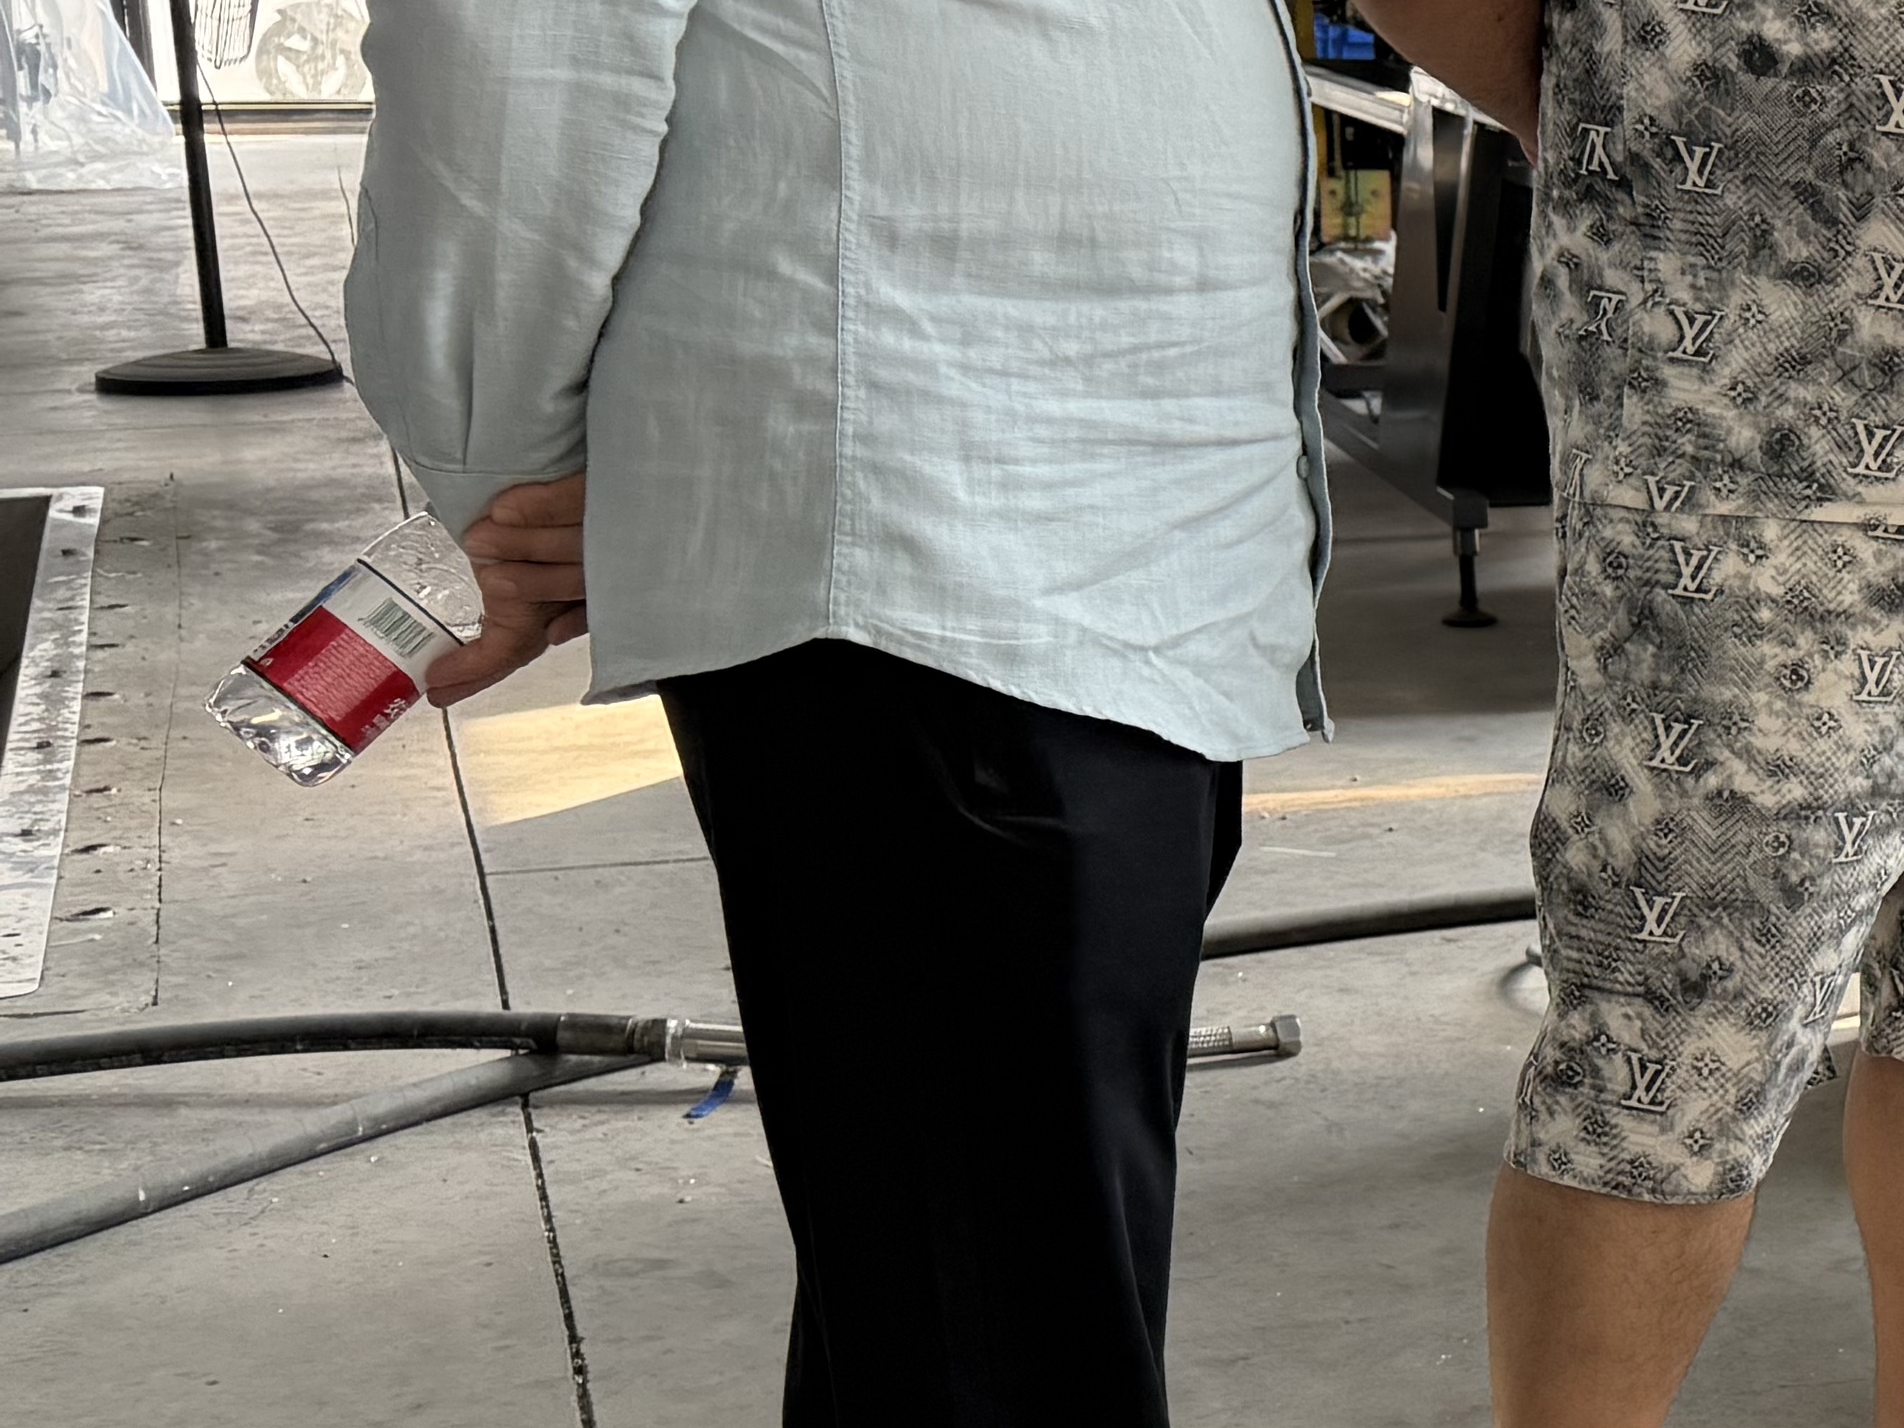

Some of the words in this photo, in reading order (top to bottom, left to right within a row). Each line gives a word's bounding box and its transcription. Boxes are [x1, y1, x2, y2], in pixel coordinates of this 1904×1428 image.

[1671, 136, 1724, 194] LV
[1669, 306, 1724, 362] LV
[1668, 542, 1723, 599] LV
[1854, 650, 1899, 702] LV
[1648, 713, 1702, 771] LV
[1630, 887, 1687, 943] LV
[1621, 1051, 1672, 1112] LV
